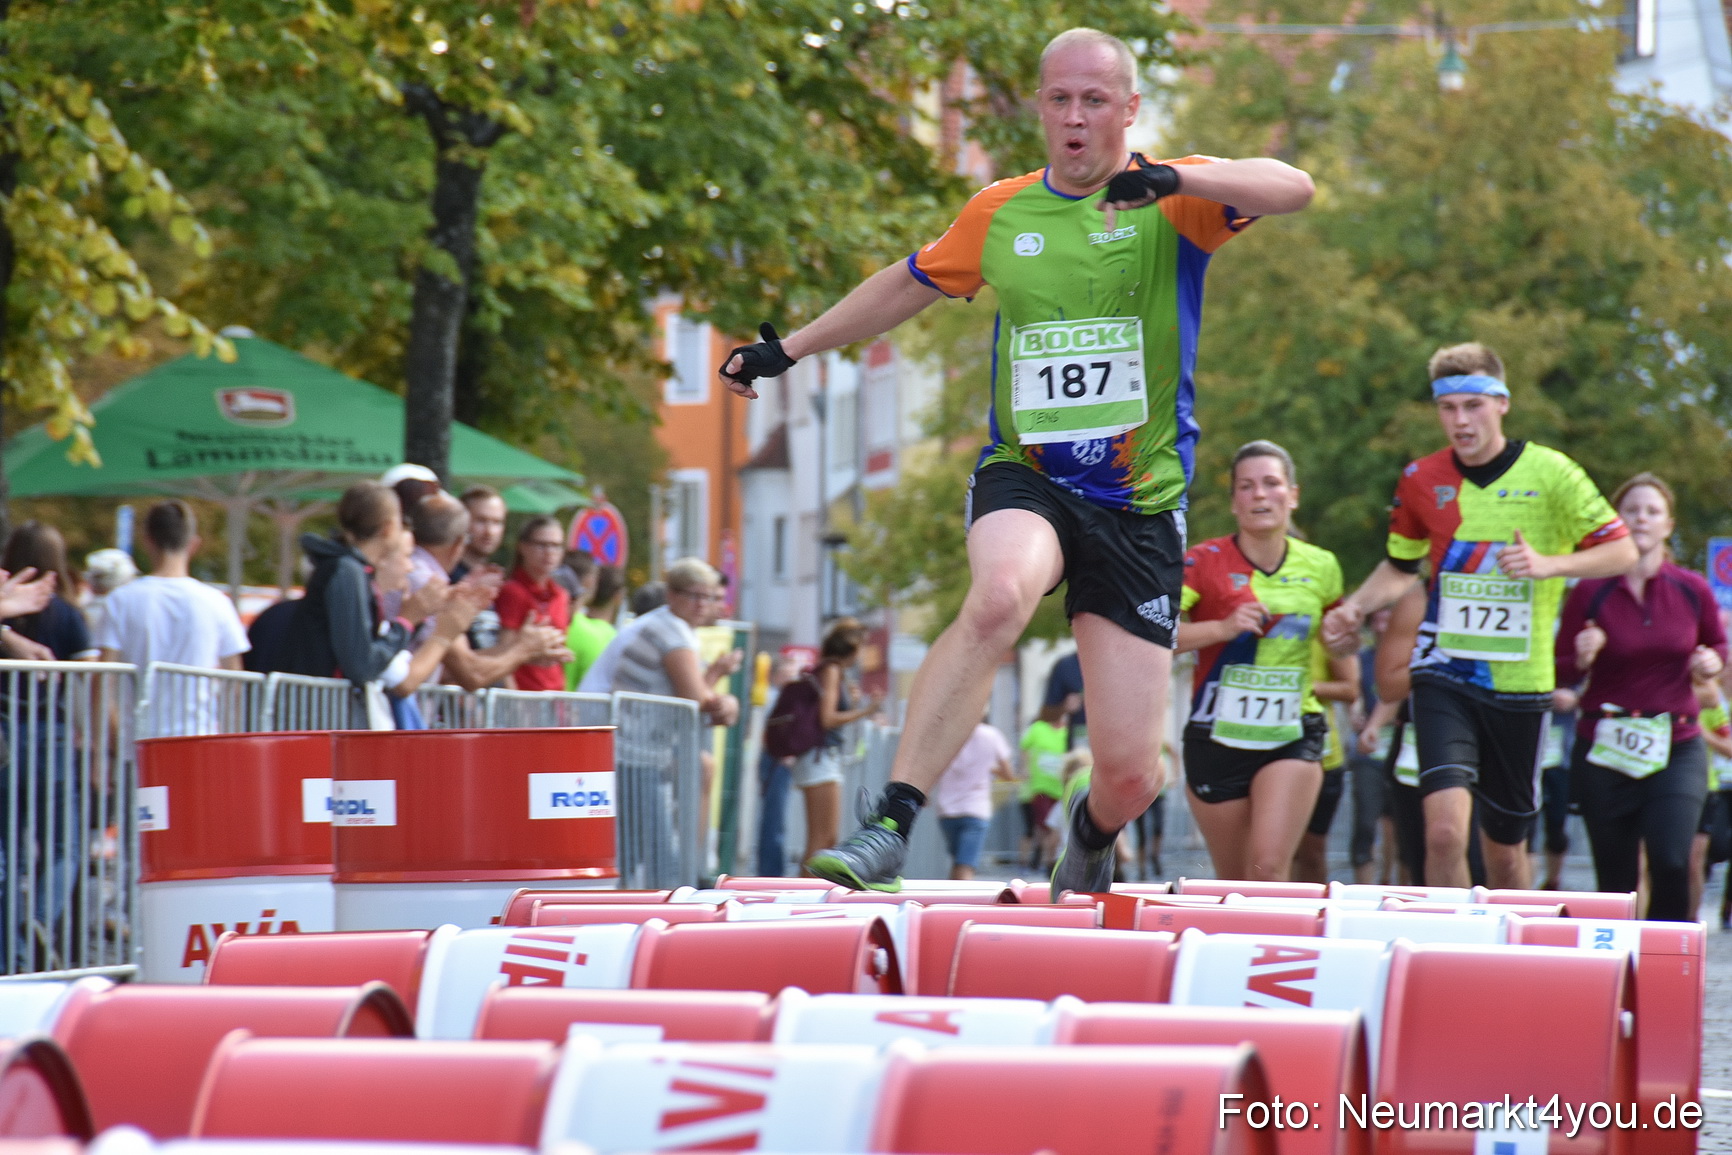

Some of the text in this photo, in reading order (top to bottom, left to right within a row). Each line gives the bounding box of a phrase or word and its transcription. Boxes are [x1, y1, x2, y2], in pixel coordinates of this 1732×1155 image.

[1020, 324, 1128, 355] BOCK
[1038, 361, 1112, 400] 187
[1448, 578, 1522, 599] BOCK
[1458, 605, 1510, 631] 172
[1229, 669, 1297, 688] BOCK
[1238, 695, 1285, 721] 171
[1614, 727, 1655, 756] 102
